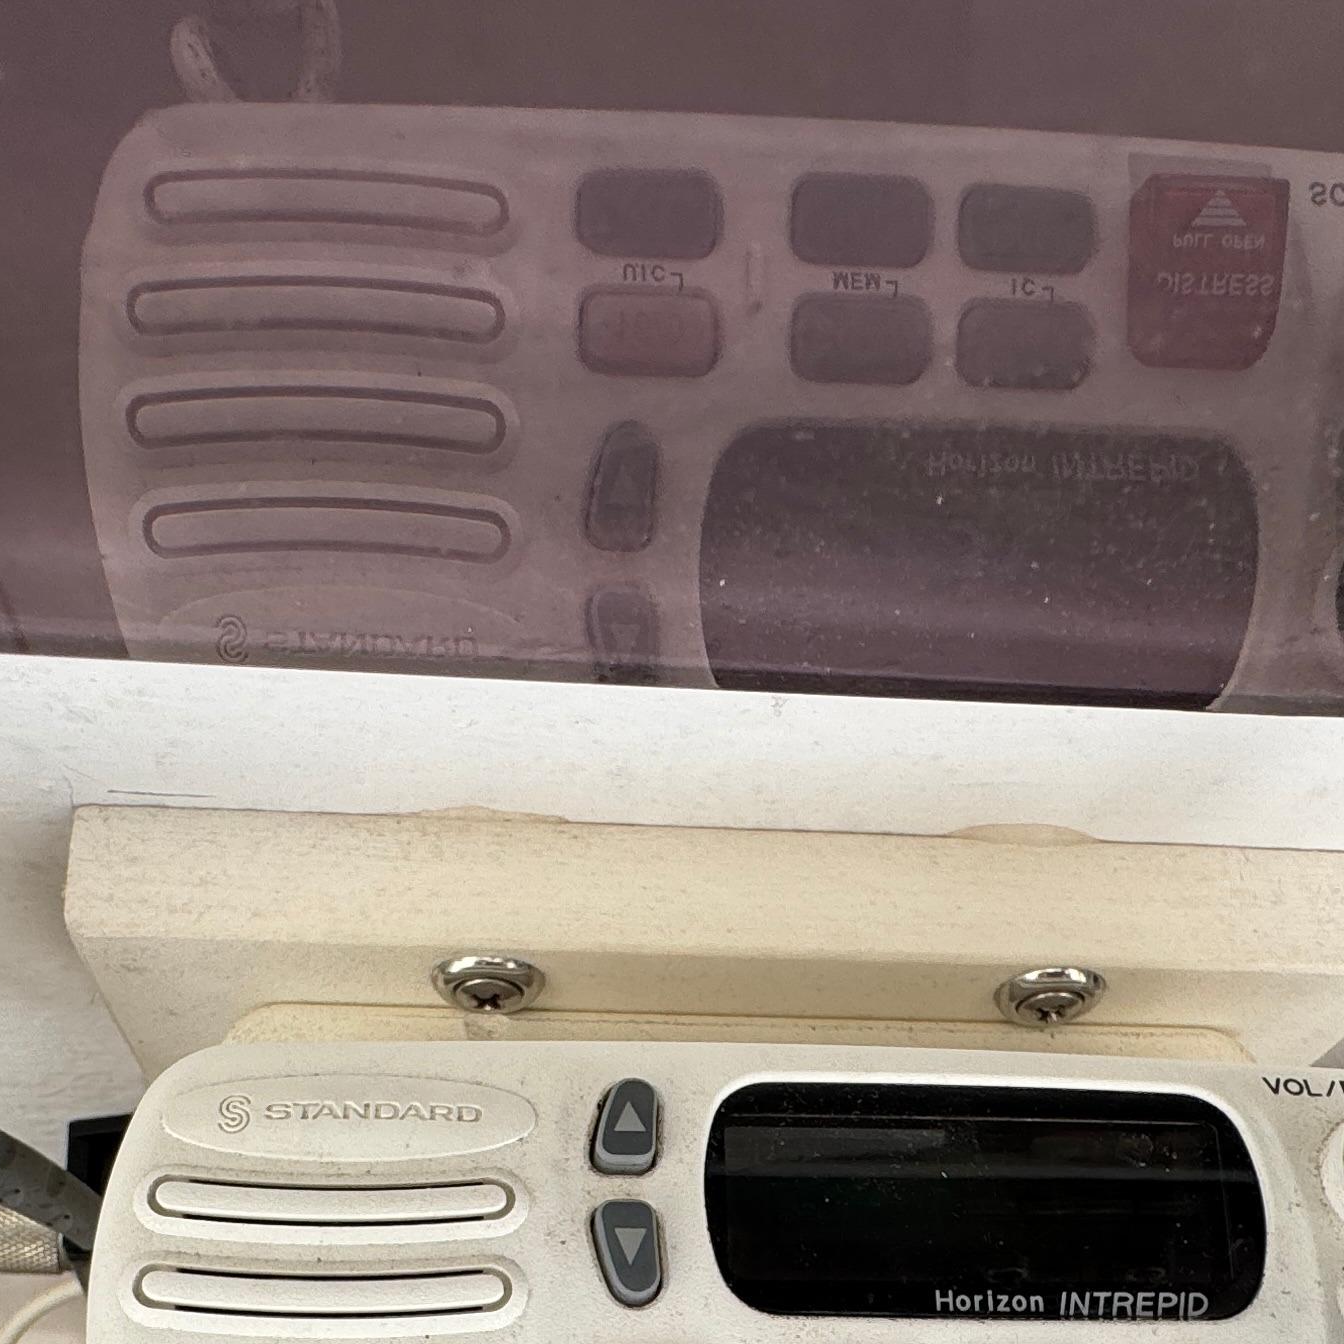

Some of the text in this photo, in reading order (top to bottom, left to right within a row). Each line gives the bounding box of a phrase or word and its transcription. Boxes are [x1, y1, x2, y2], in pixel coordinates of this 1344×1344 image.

[263, 1100, 484, 1123] STANDARD
[934, 1289, 1210, 1318] Horizon INTREPID
